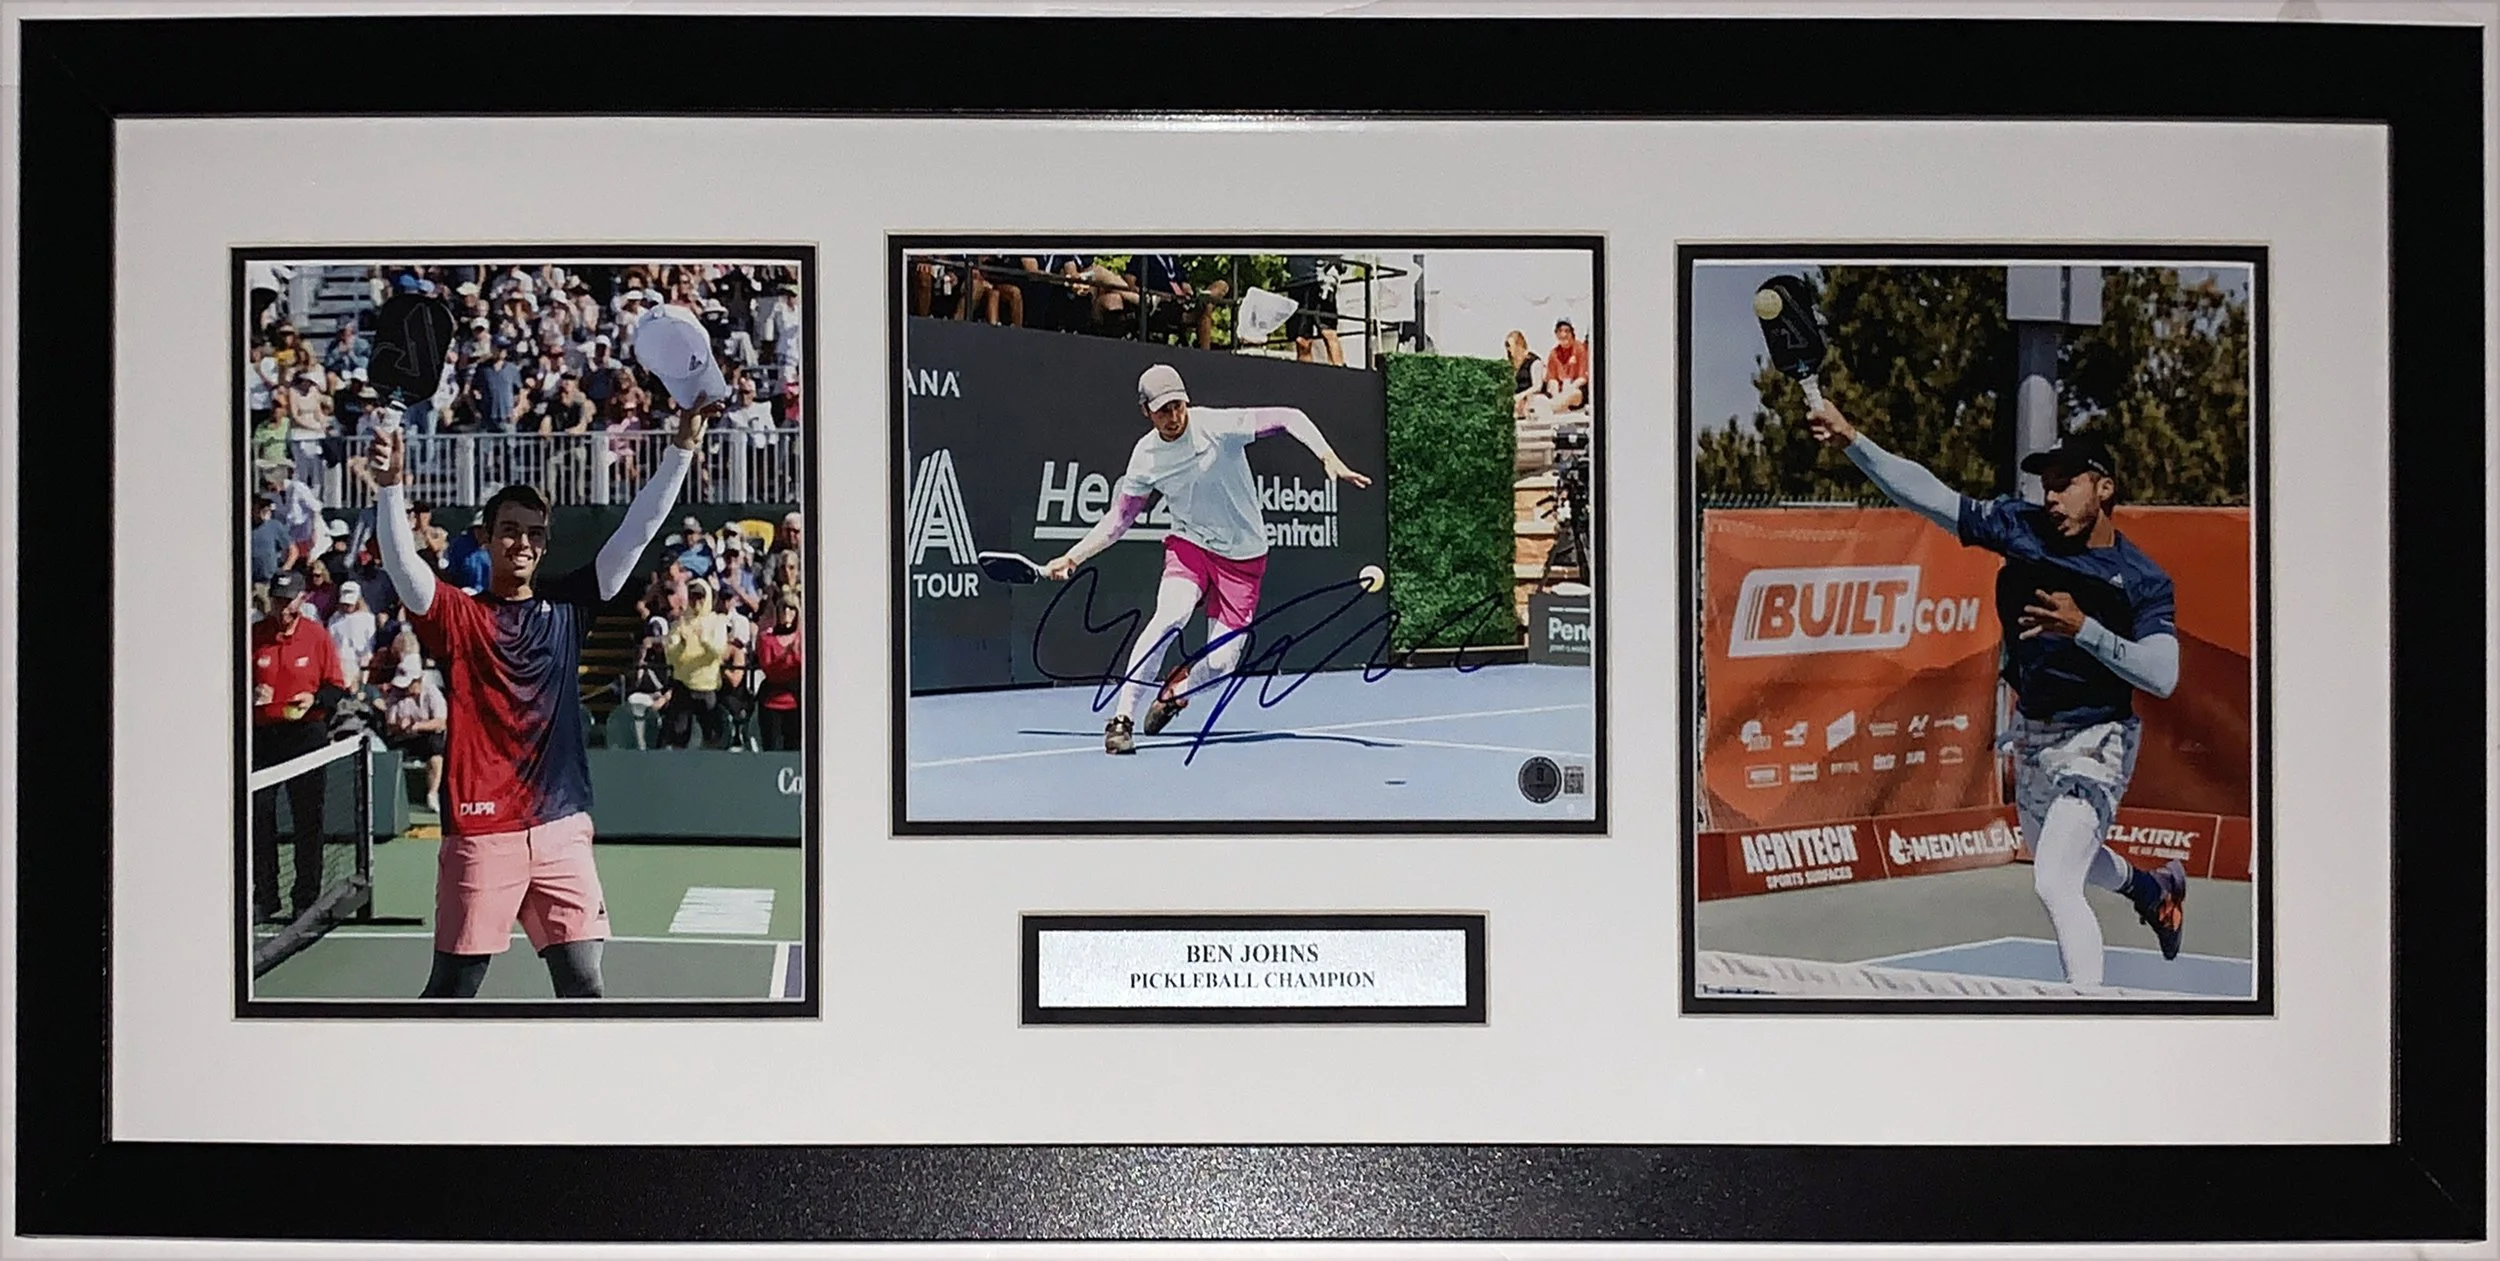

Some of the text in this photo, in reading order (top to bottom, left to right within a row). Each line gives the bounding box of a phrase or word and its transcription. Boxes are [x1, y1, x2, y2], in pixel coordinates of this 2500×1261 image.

[1257, 475, 1337, 513] kleball
[1264, 515, 1331, 547] entral
[913, 573, 979, 598] TOUR
[461, 801, 496, 816] DUPR
[1740, 825, 1858, 874] ACRYTECH
[1187, 944, 1319, 963] BEN JOHNS
[1130, 971, 1376, 989] PICKLEBALL CHAMPION
